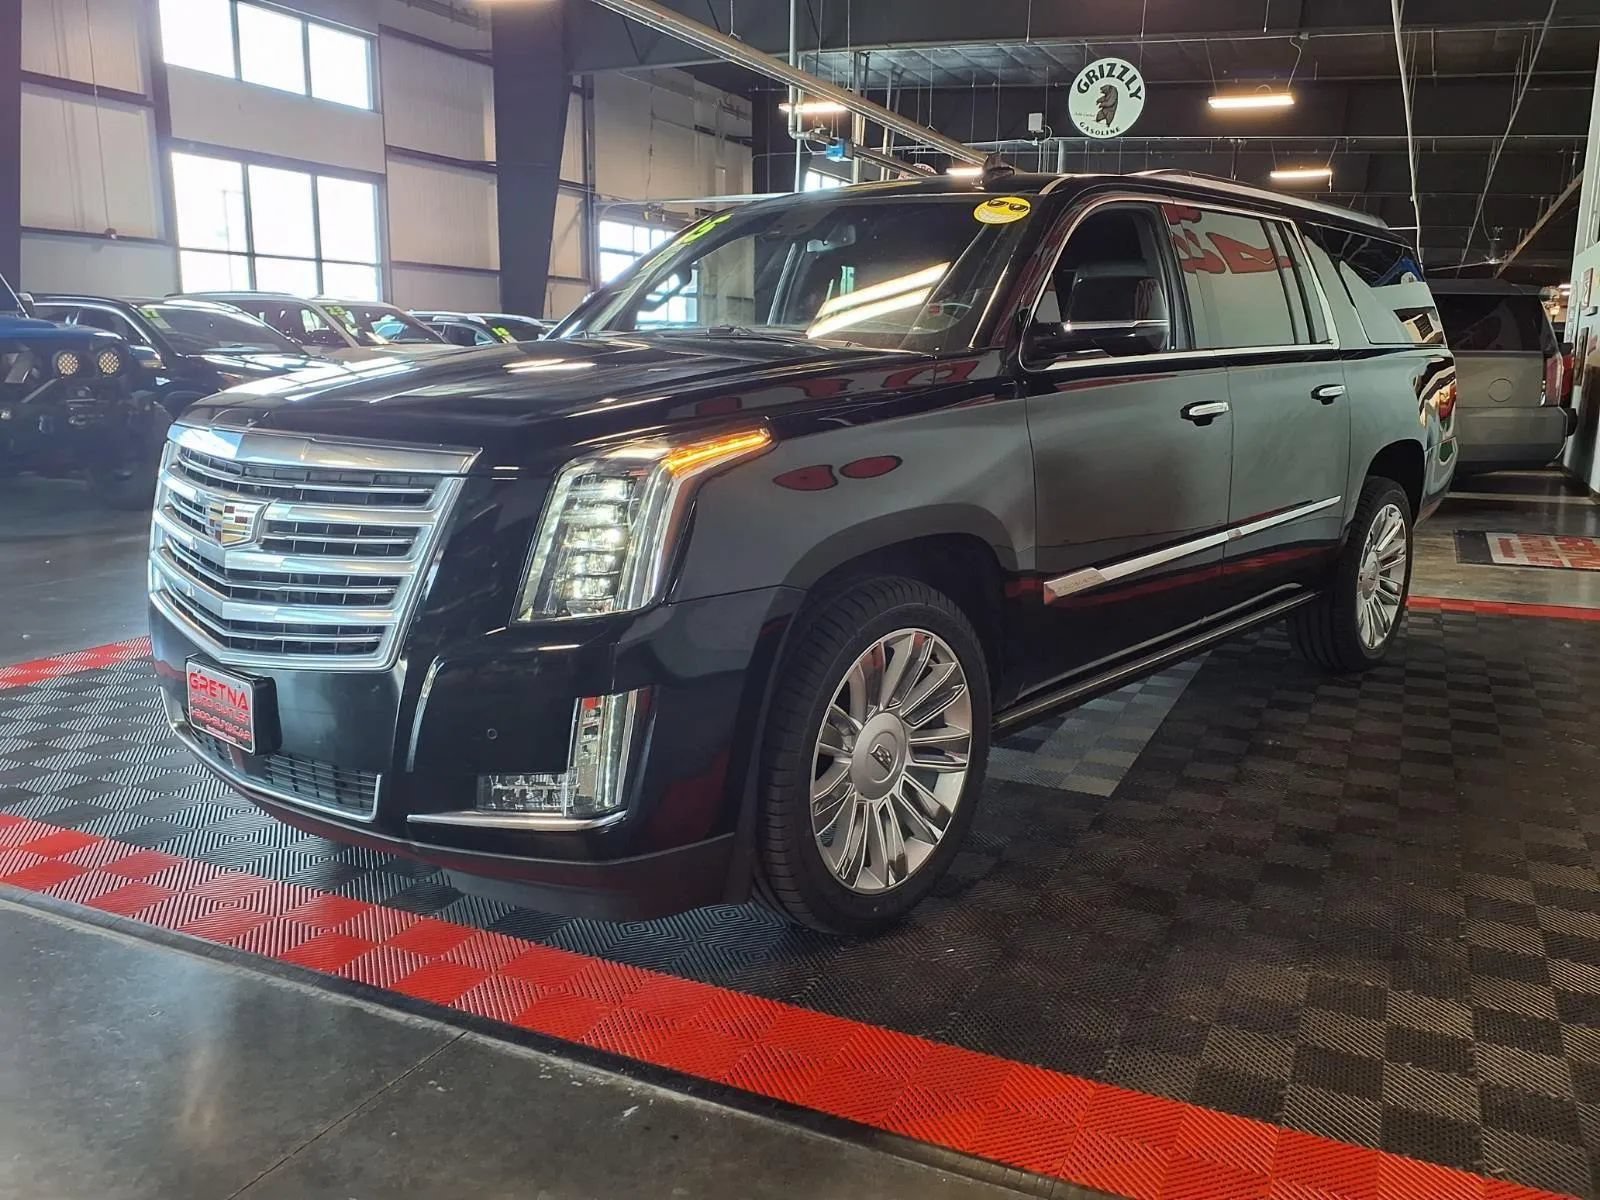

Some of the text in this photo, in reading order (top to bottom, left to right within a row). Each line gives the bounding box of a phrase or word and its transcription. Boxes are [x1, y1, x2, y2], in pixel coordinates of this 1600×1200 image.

[1077, 63, 1142, 100] GRIZZLY
[1080, 122, 1120, 136] GASOLINE
[189, 672, 249, 711] GRETNA
